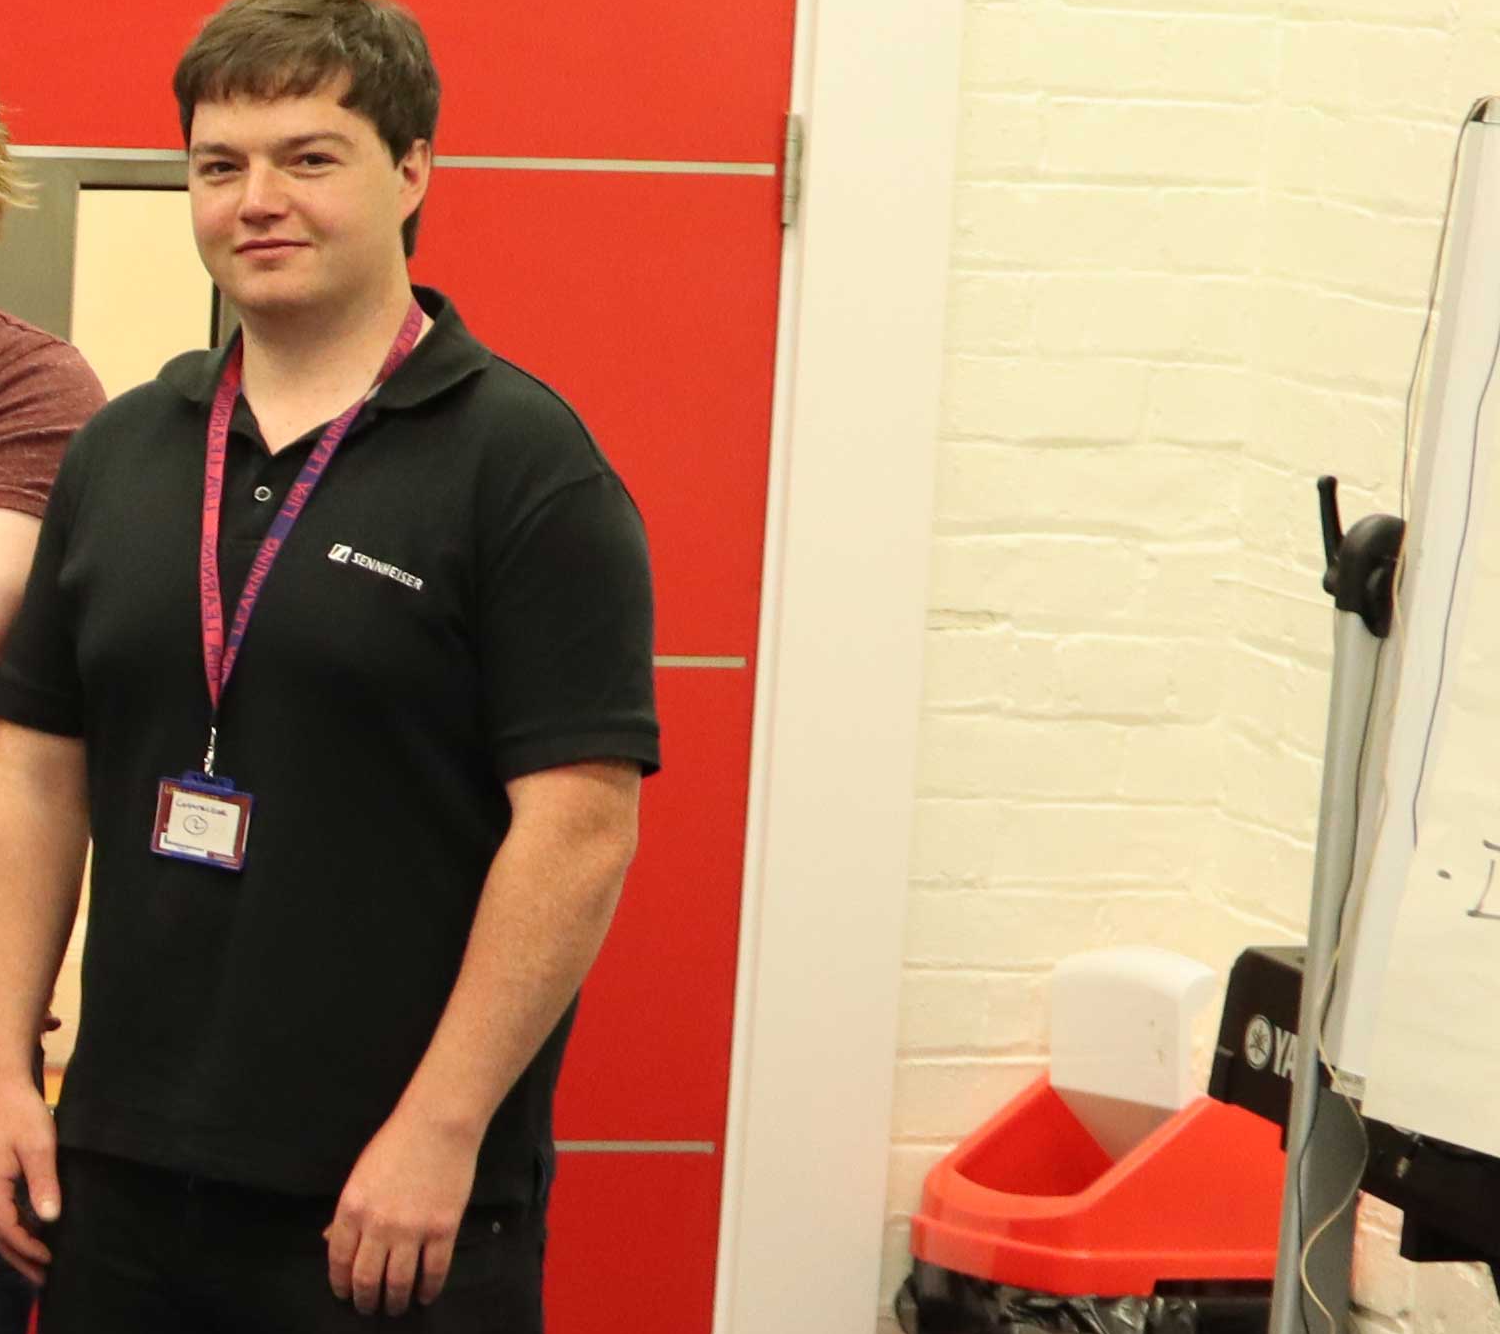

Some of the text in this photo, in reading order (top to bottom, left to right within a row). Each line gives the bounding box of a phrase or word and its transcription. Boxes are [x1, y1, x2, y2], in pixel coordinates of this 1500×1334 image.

[233, 538, 281, 636] LEARNING
[280, 481, 314, 519] LIPA
[350, 552, 424, 591] SENNHEISER
